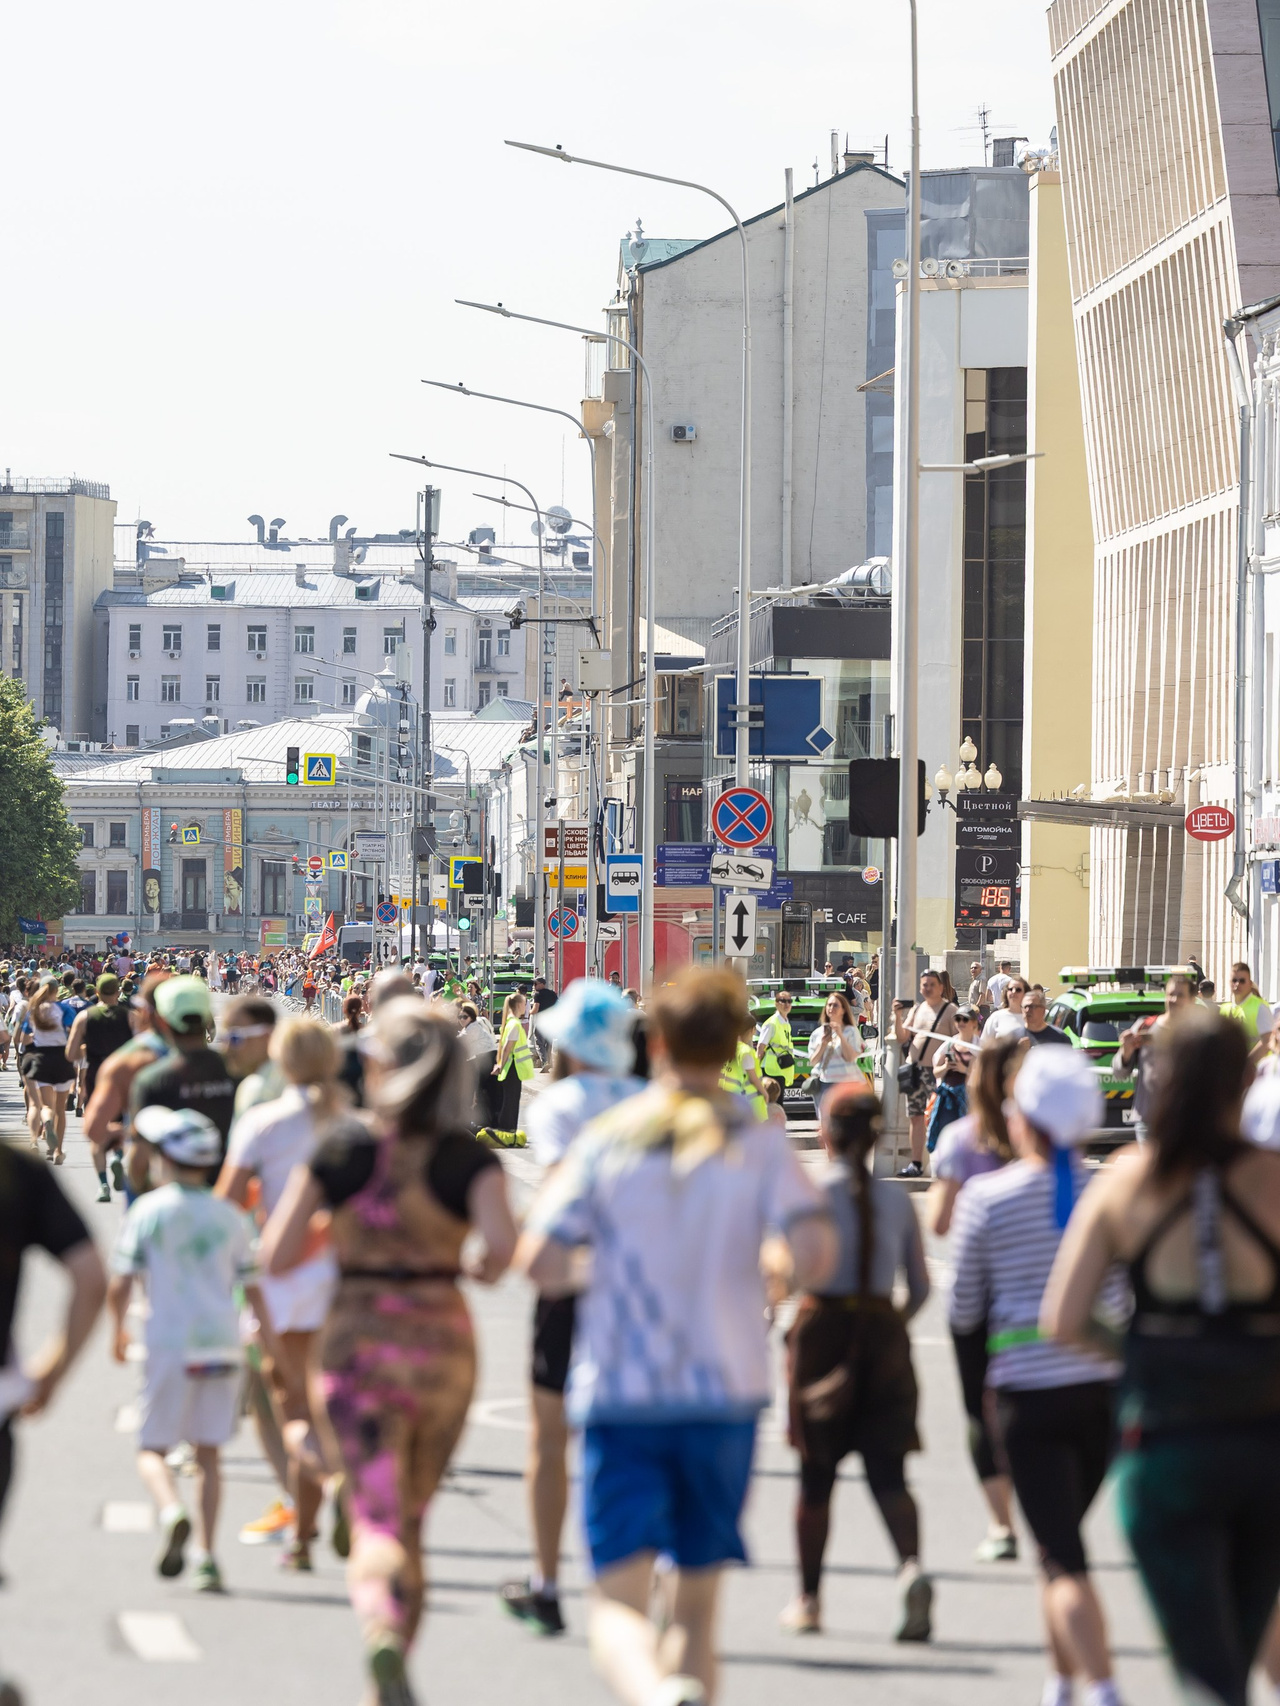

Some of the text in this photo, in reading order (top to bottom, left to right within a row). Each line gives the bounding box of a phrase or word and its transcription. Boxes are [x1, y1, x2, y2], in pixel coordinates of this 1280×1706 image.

[682, 788, 702, 796] КАР
[963, 800, 1012, 812] Цветной
[1191, 812, 1230, 829] ЦВЕТЫ
[980, 886, 1010, 907] 186
[837, 913, 867, 923] CAFE
